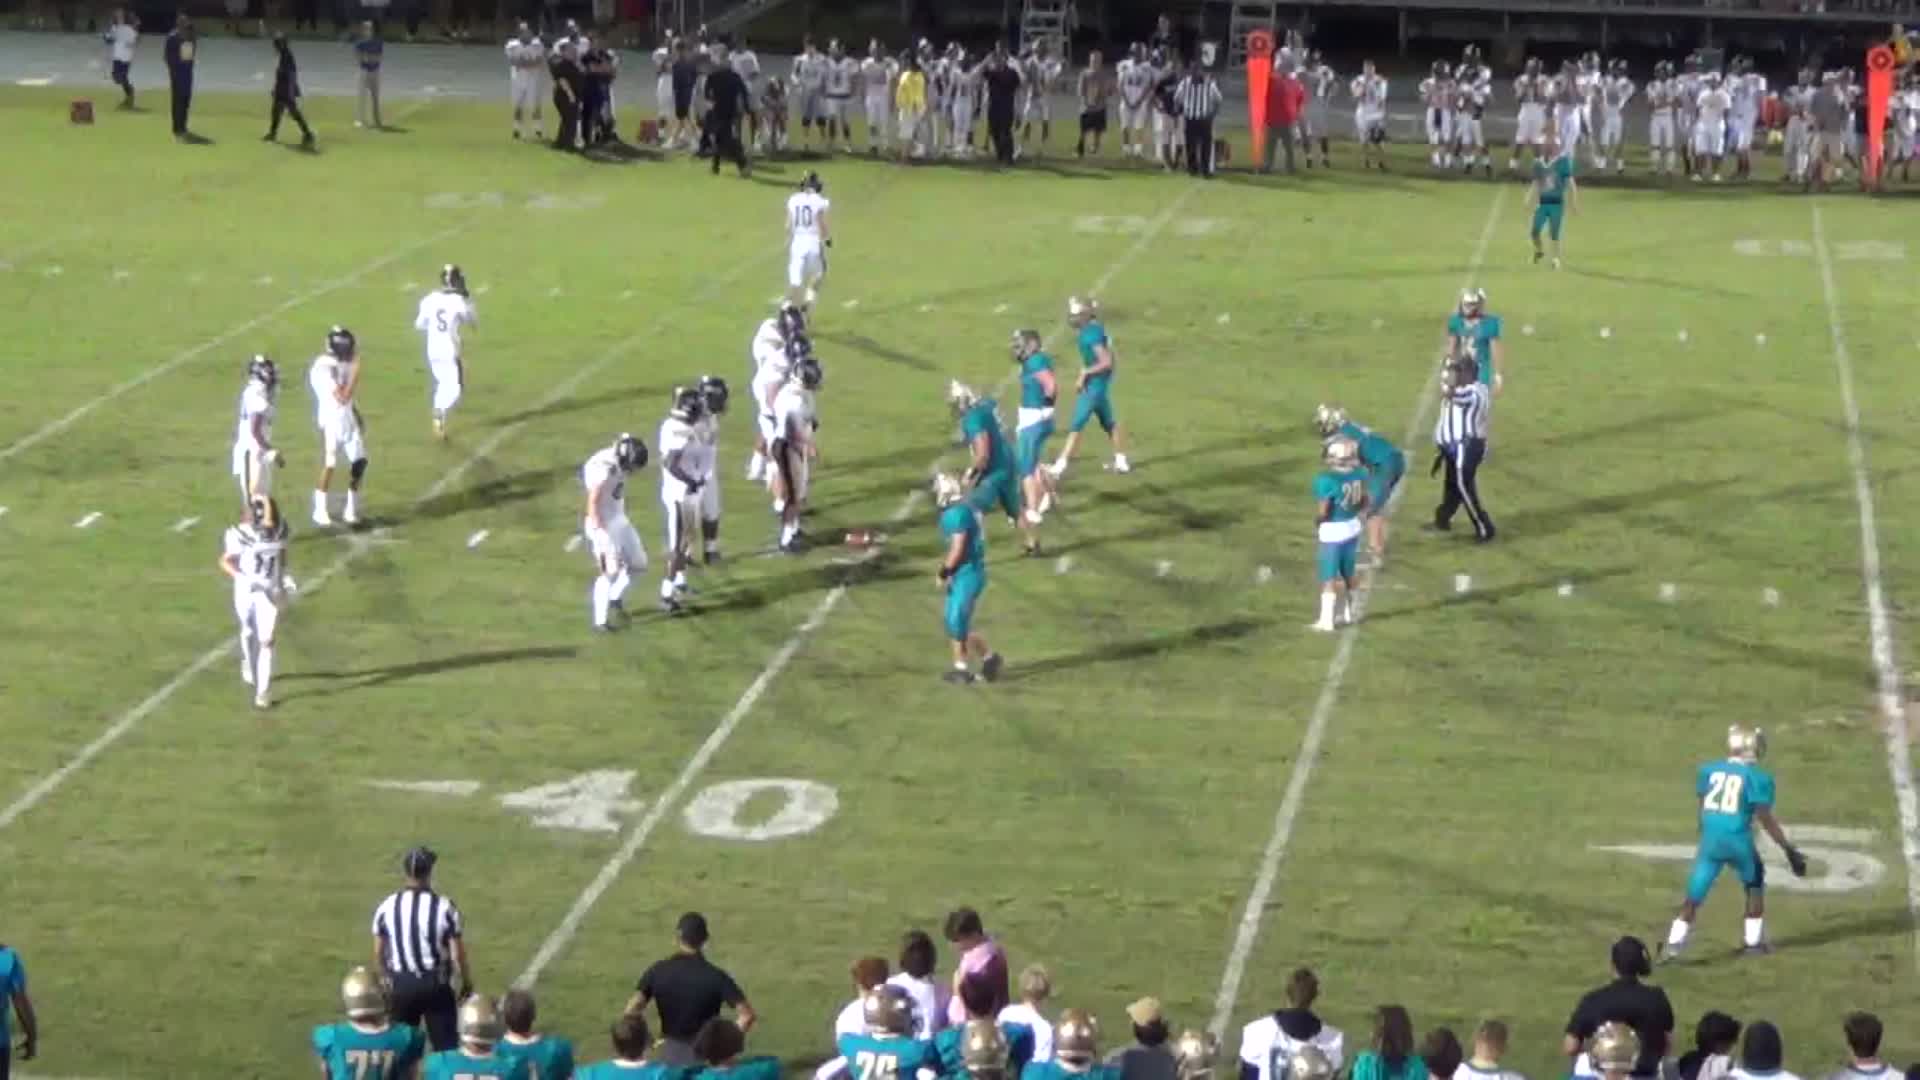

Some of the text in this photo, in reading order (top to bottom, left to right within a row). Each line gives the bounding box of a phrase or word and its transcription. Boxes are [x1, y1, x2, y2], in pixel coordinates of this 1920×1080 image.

[794, 204, 813, 228] 10
[435, 307, 448, 333] 5
[1340, 479, 1362, 511] 20
[496, 768, 841, 842] 40
[1703, 770, 1743, 815] 28
